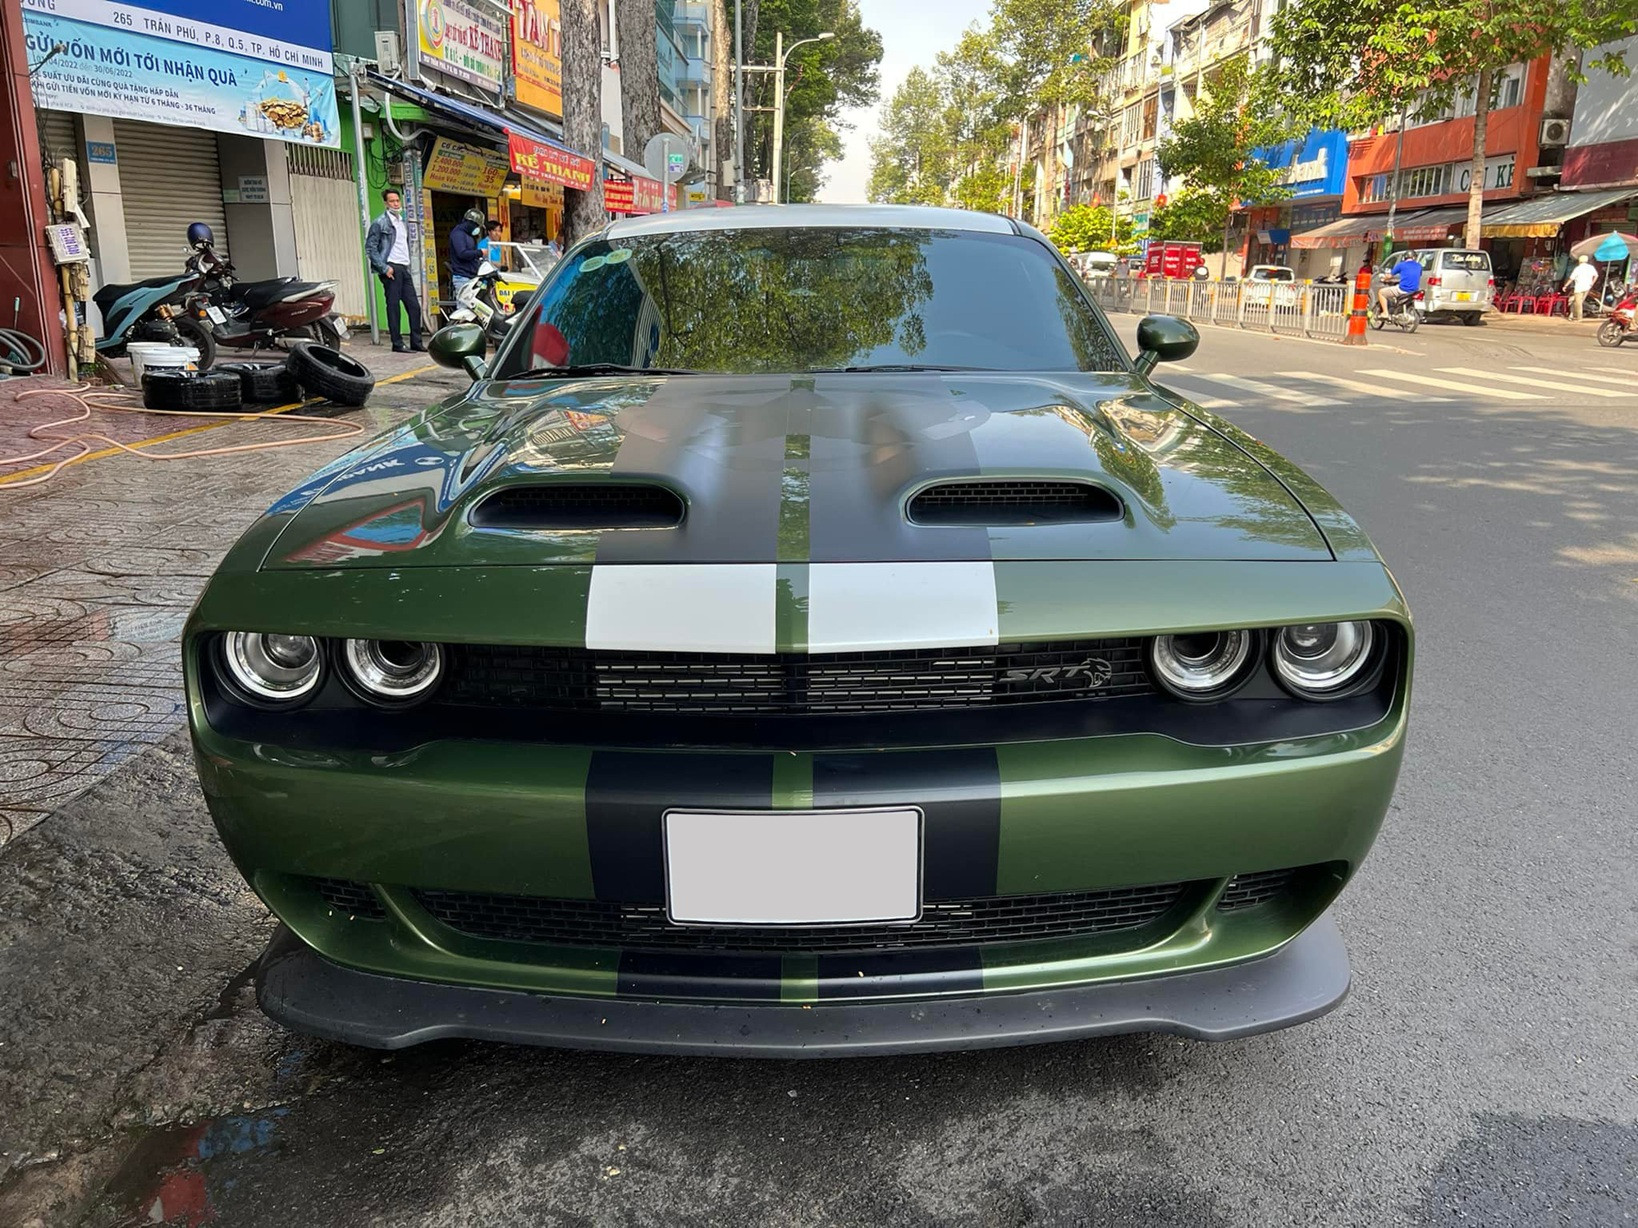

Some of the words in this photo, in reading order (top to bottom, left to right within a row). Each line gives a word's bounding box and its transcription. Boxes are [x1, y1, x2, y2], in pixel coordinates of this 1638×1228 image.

[113, 11, 133, 26] 265
[176, 26, 199, 42] PHÚ,
[205, 31, 224, 47] P.8,
[228, 37, 247, 52] Q.5,
[251, 42, 265, 55] TP.
[302, 54, 323, 68] MINH
[59, 38, 95, 60] VỐN
[99, 47, 130, 66] MỚI
[134, 52, 159, 72] TỚI
[163, 59, 204, 82] NHẬN
[208, 68, 237, 87] QUÀ
[94, 65, 133, 78] 30/06/2022
[184, 103, 193, 111] 36
[515, 152, 539, 169] KẾ
[543, 160, 591, 184] THANH
[485, 175, 495, 184] 35
[999, 665, 1091, 683] SRT
